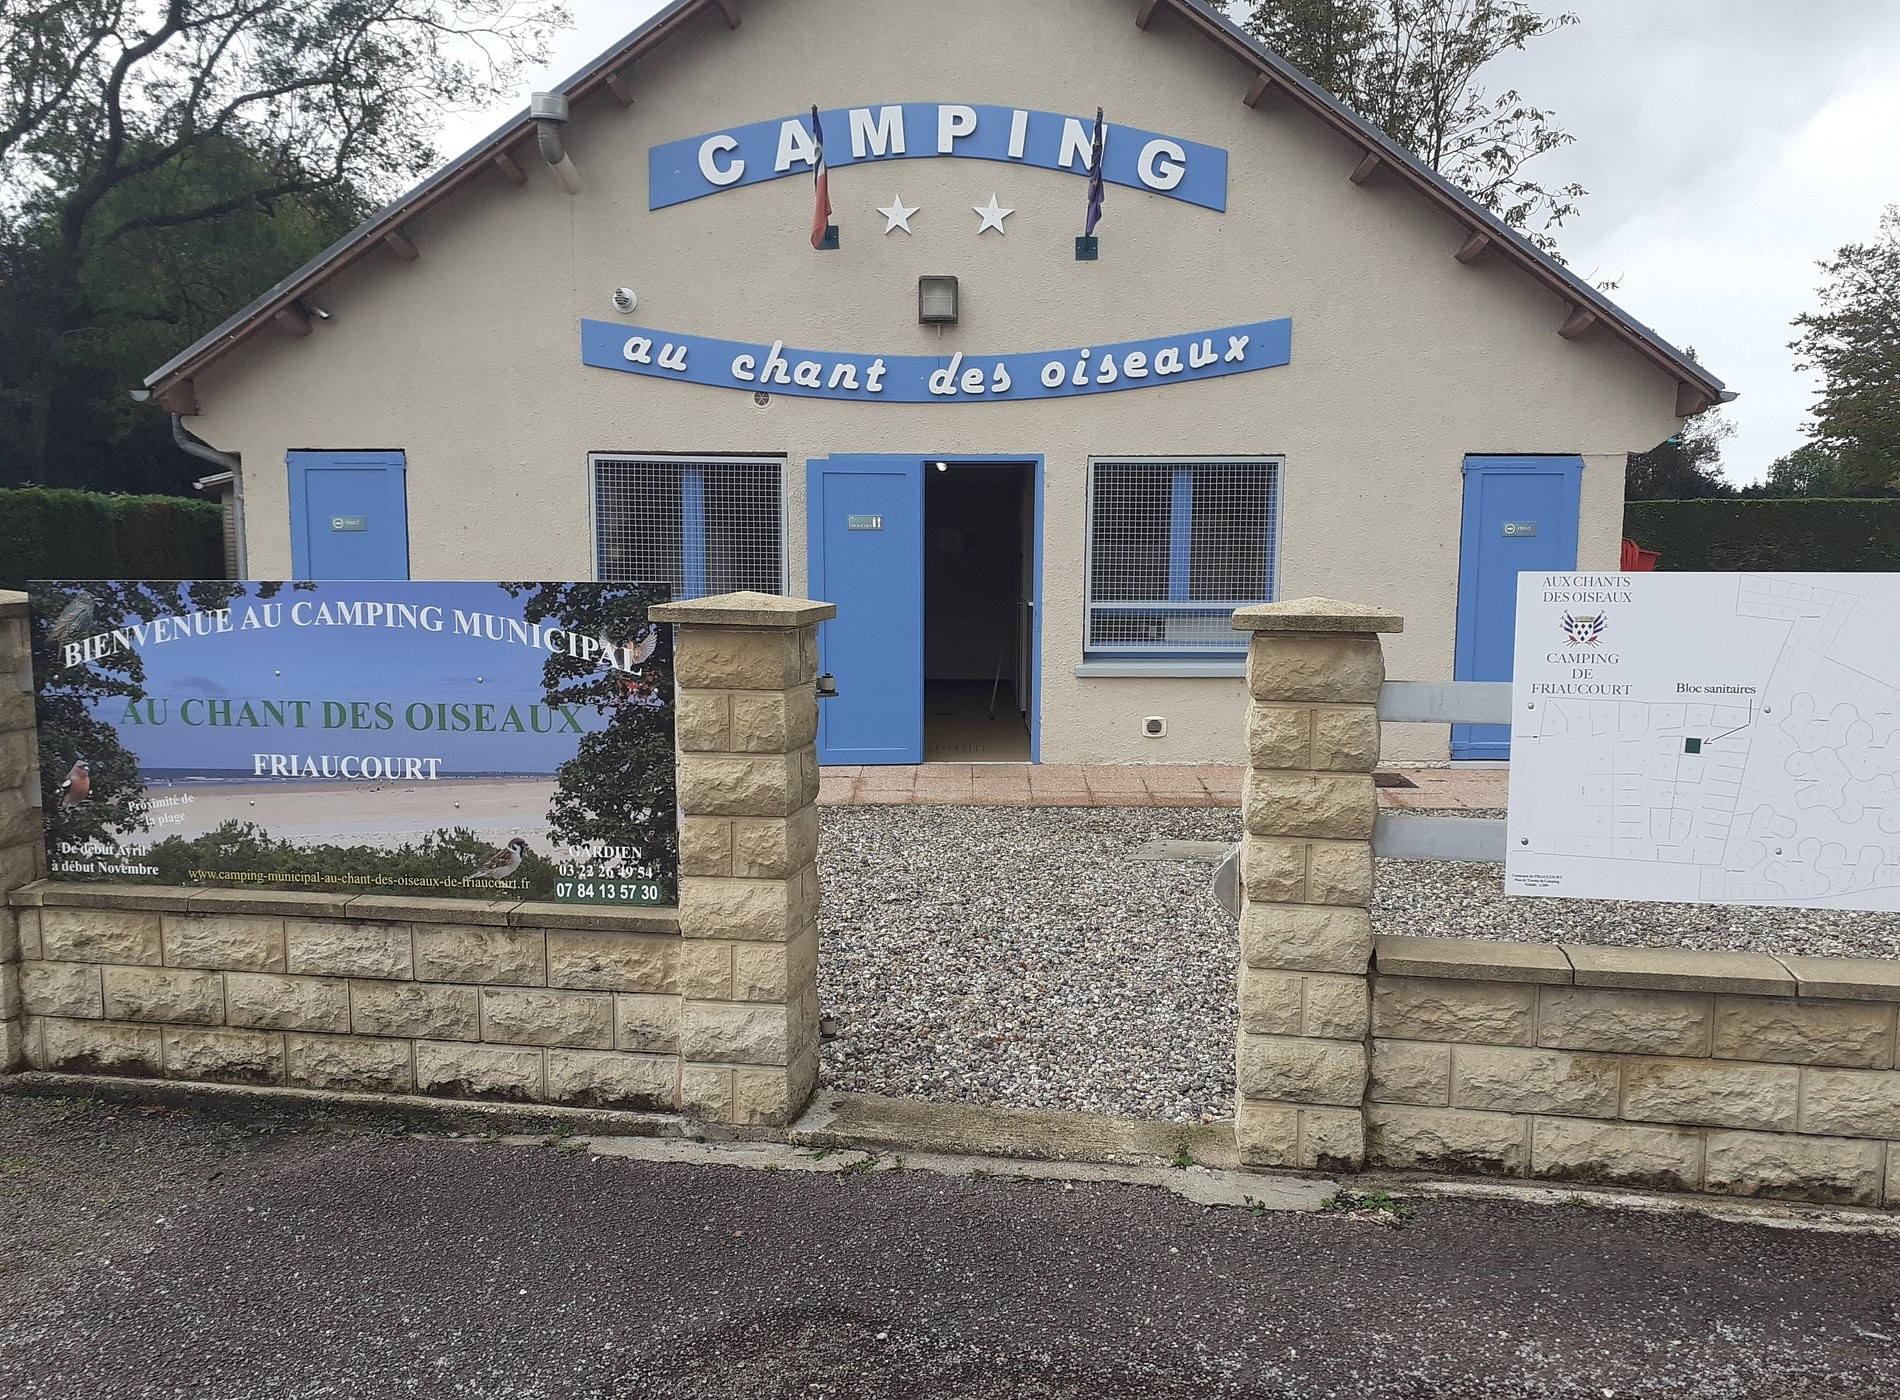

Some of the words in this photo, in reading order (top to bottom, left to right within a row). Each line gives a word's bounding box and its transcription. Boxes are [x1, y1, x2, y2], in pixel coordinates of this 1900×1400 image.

[698, 105, 1186, 190] CAMPING
[623, 336, 687, 371] au
[731, 340, 886, 392] chant
[929, 352, 1011, 395] des
[1041, 335, 1250, 388] oiseaux
[1542, 576, 1571, 587] AUX
[1573, 576, 1631, 587] CHANTS
[1543, 592, 1569, 602] DES
[1572, 592, 1632, 603] OISEAUX
[63, 608, 233, 668] BIENVENUE
[240, 603, 282, 630] AU
[291, 601, 444, 632] CAMPING
[452, 609, 643, 676] MUNICIPAL
[1546, 653, 1619, 664] CAMPING
[1572, 668, 1593, 679] DE
[1531, 683, 1633, 695] FRIAUCOURT
[1676, 682, 1702, 693] Bloc
[1704, 684, 1756, 694] sanitaires
[120, 698, 168, 726] AU
[180, 699, 311, 728] CHANT
[322, 701, 394, 730] DES
[405, 703, 584, 734] OISEAUX
[252, 753, 442, 780] FRIAUCOURT
[128, 794, 179, 812] Proximité
[181, 793, 194, 804] de
[145, 815, 155, 826] la
[158, 811, 186, 827] plage
[61, 842, 76, 854] De
[80, 843, 114, 856] début
[117, 845, 146, 857] Avril
[568, 845, 642, 859] GARDIEN
[51, 860, 59, 871] à
[62, 860, 95, 873] début
[98, 862, 160, 875] Novembre
[559, 864, 574, 877] 03
[579, 865, 594, 877] 22
[598, 865, 615, 878] 26
[637, 866, 653, 879] 54
[556, 882, 573, 898] 07
[577, 883, 595, 898] 84
[599, 884, 616, 899] 13
[620, 884, 637, 899] 57
[641, 885, 658, 900] 30
